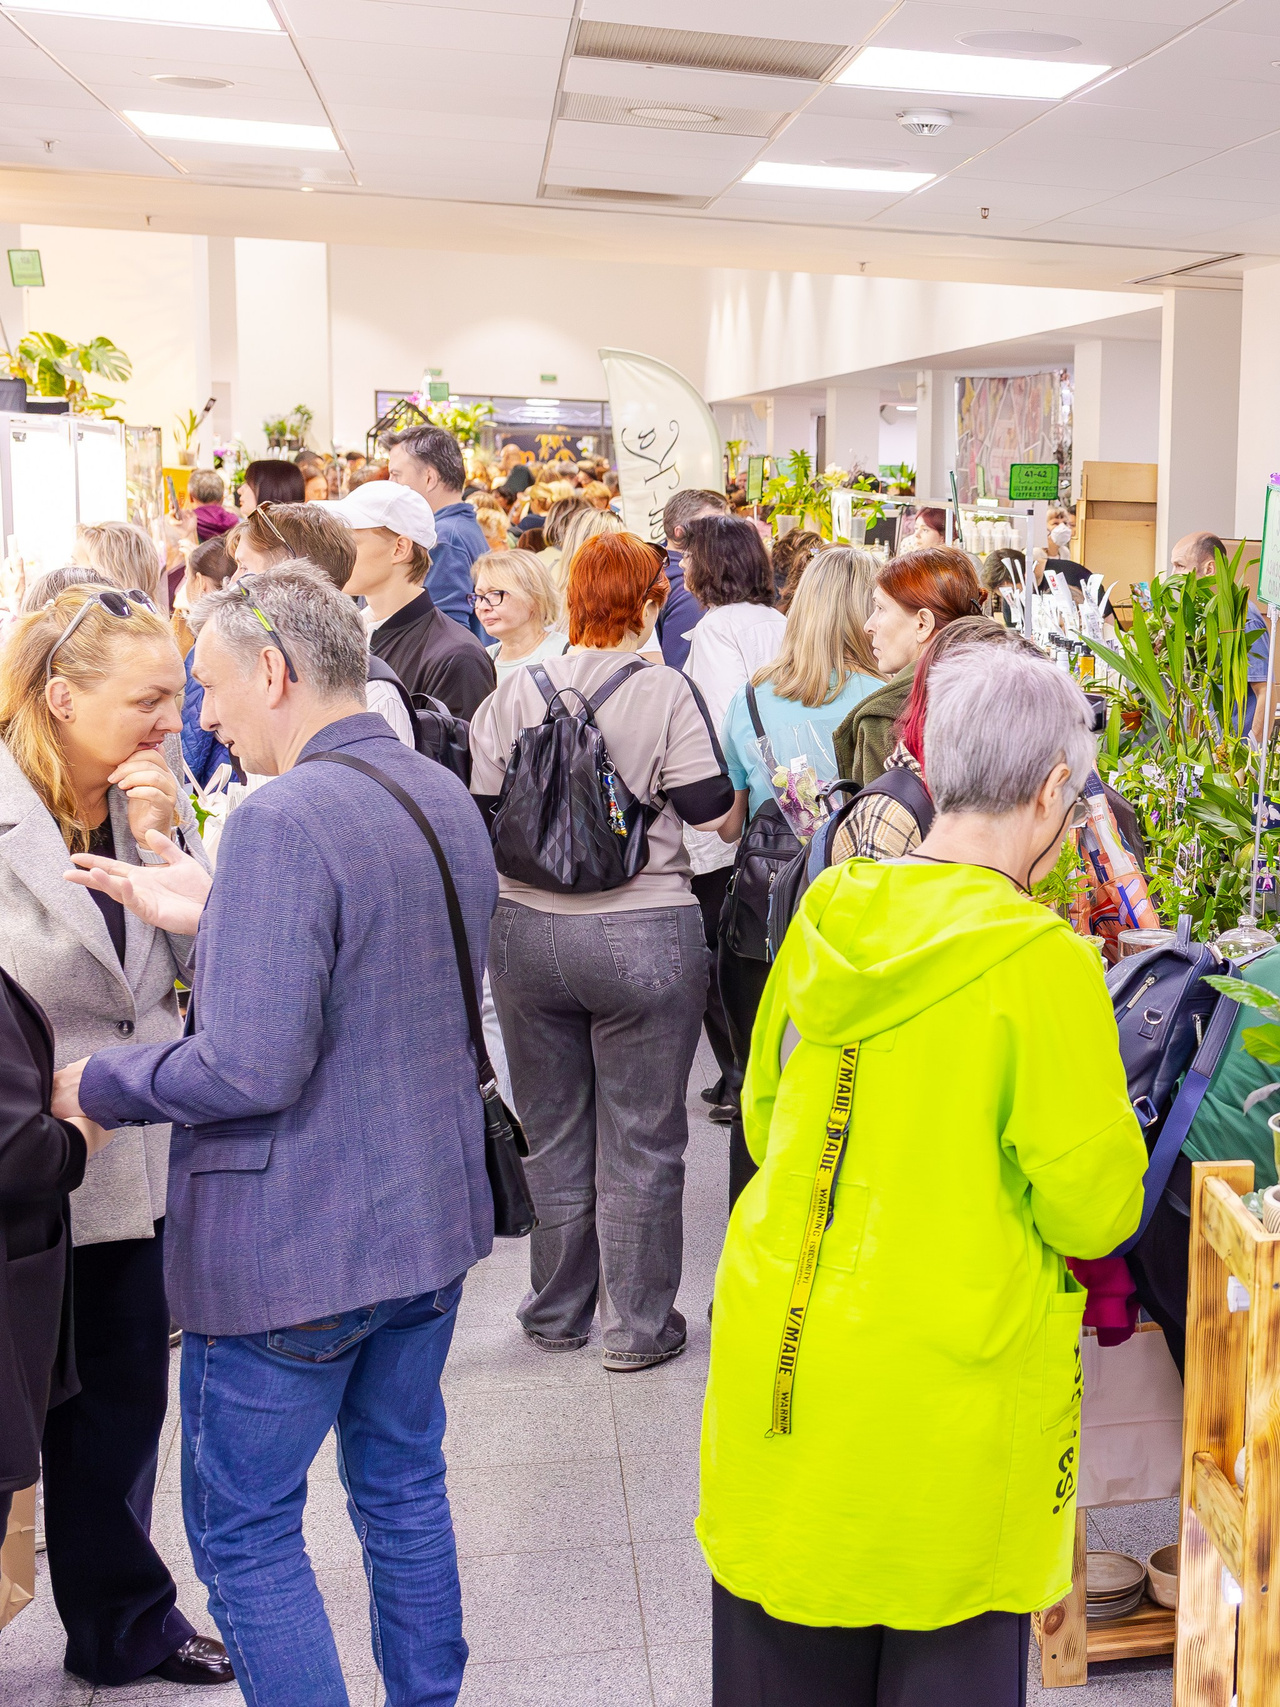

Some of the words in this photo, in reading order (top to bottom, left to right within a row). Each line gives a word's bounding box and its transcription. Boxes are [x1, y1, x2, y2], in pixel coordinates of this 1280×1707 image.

[833, 1047, 856, 1117] V/MADE
[812, 1188, 828, 1238] WARNING
[778, 1306, 804, 1377] V/MADE
